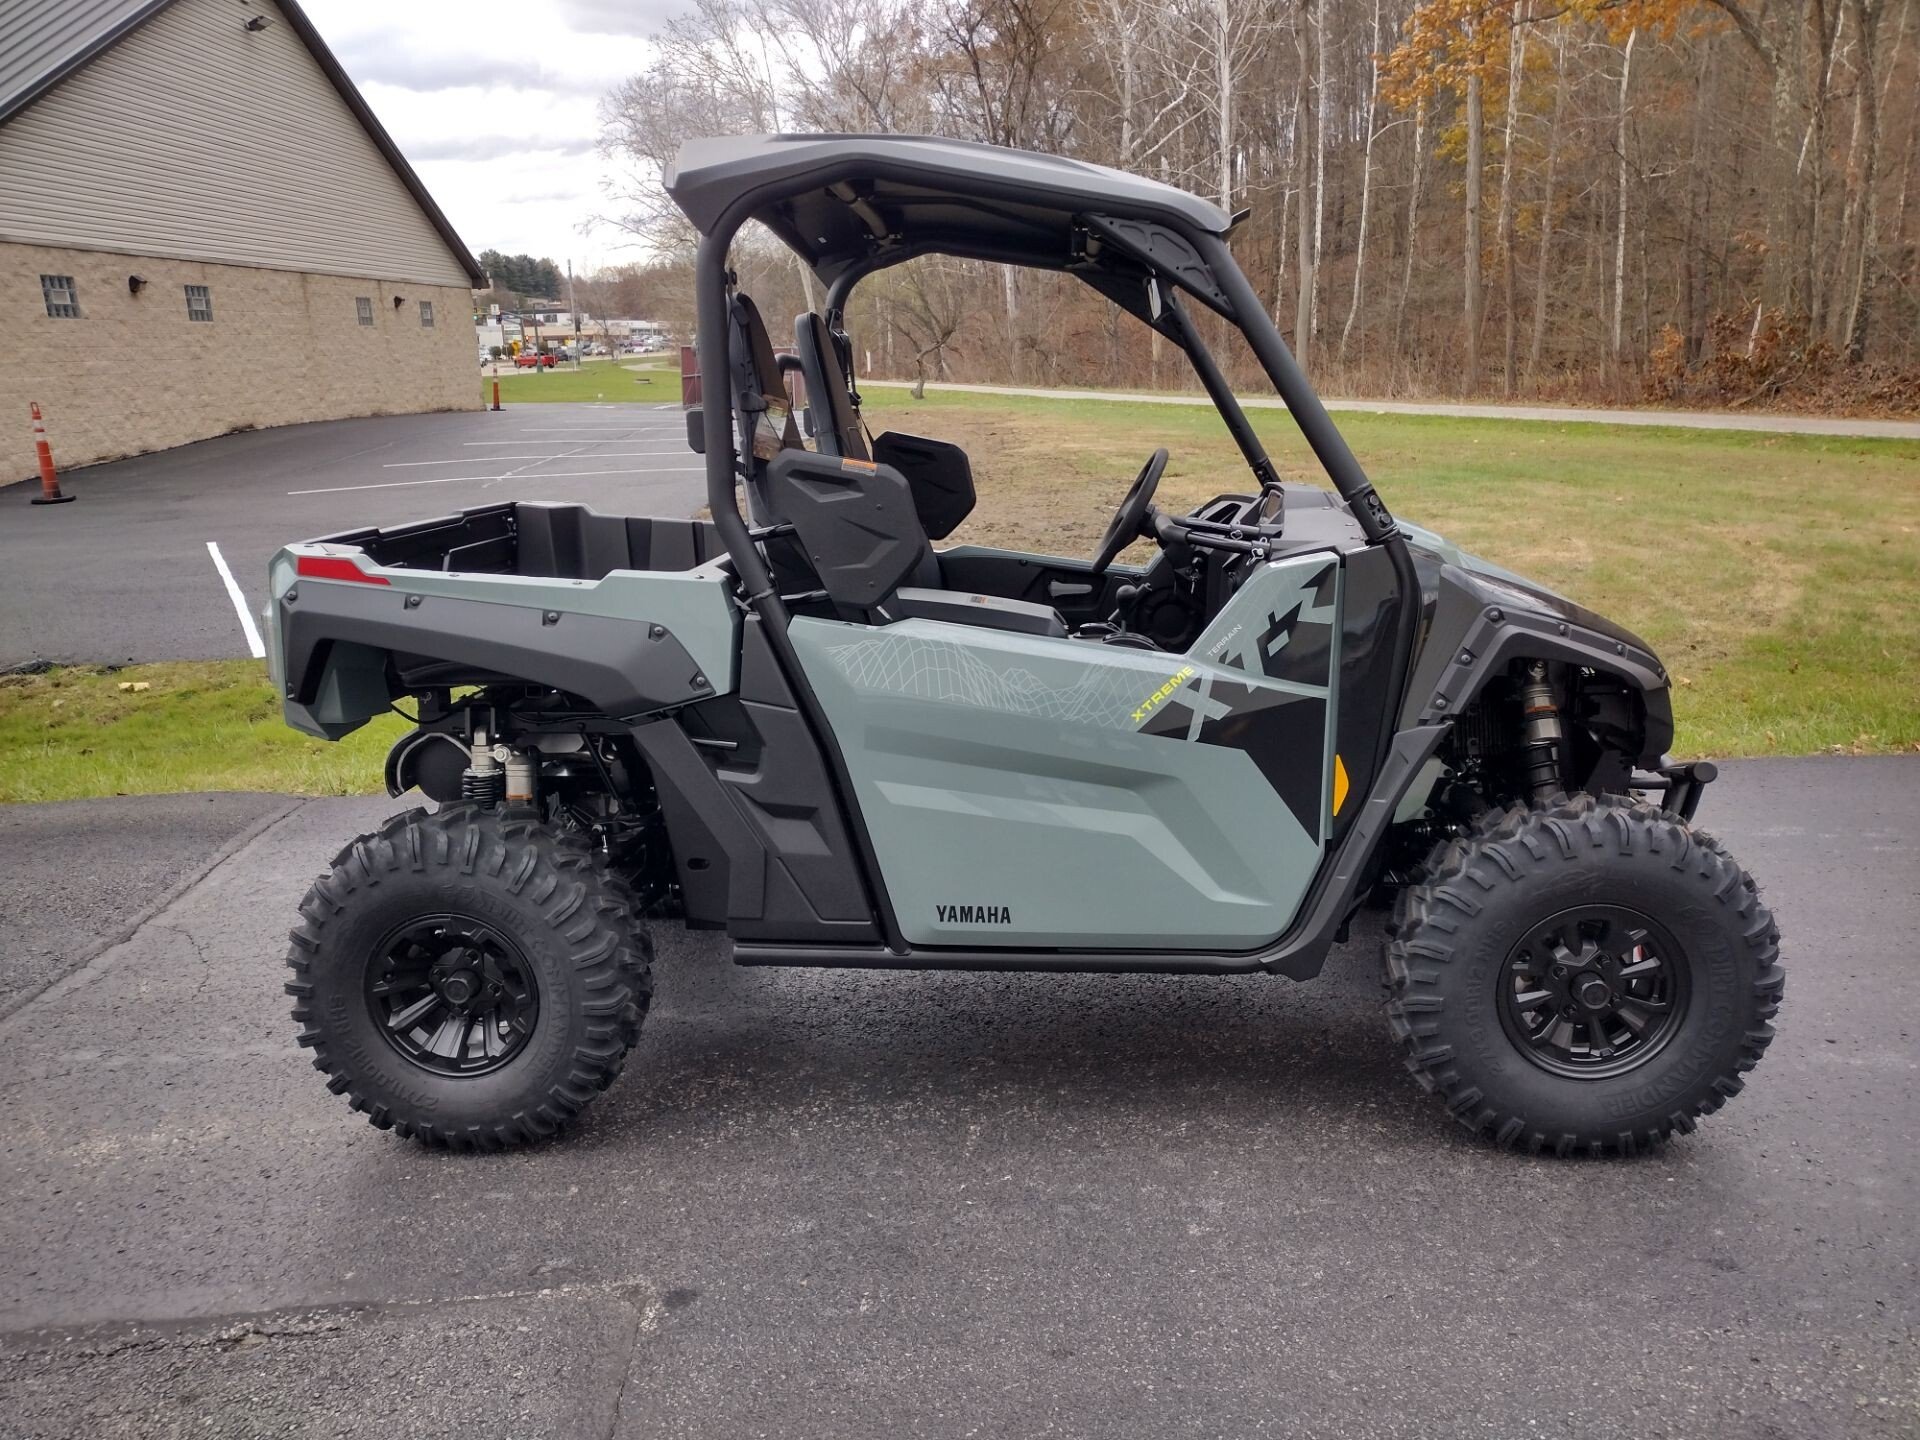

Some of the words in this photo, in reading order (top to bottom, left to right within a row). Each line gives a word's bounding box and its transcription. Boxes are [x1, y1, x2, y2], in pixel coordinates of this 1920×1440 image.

[1131, 665, 1195, 723] XTREME
[1207, 624, 1243, 657] TERRAIN
[936, 905, 1012, 924] YAMAHA
